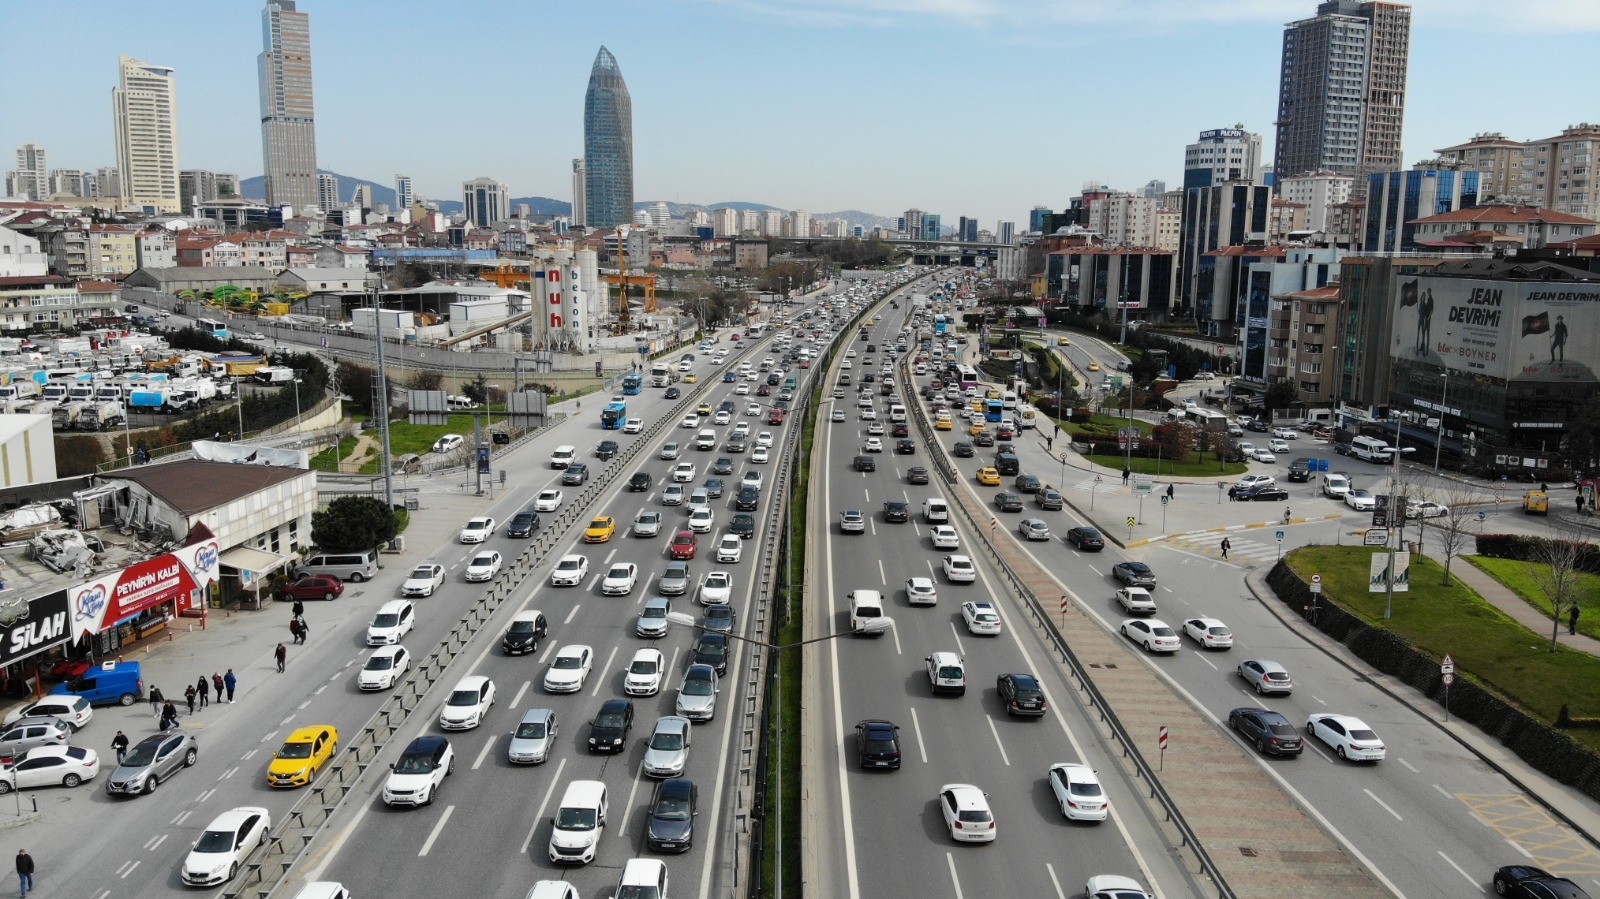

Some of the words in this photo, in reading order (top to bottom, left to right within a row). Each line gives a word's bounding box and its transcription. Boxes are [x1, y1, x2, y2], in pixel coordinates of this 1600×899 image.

[549, 270, 562, 328] nuh
[571, 270, 579, 328] beton
[1467, 287, 1503, 306] JEAN
[1526, 291, 1556, 301] JEAN
[1459, 347, 1496, 363] BOYNER
[157, 562, 180, 580] KALBİ
